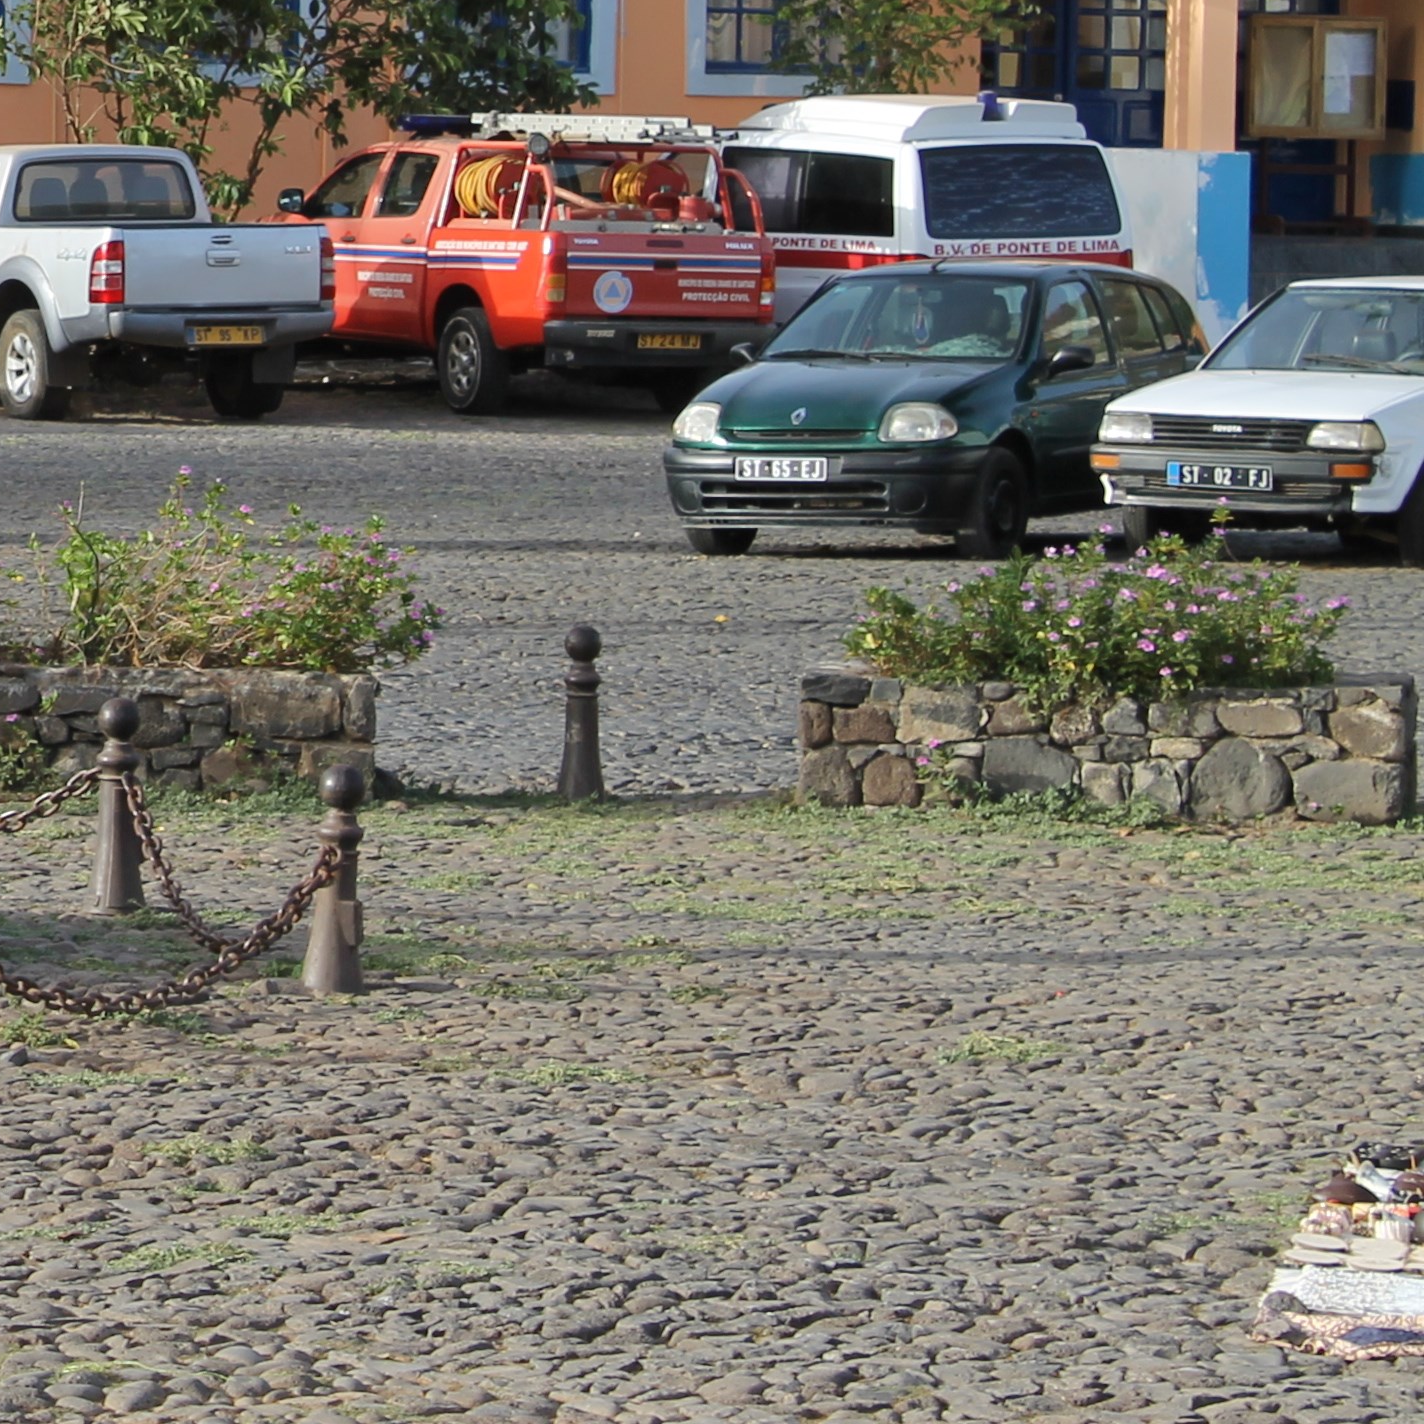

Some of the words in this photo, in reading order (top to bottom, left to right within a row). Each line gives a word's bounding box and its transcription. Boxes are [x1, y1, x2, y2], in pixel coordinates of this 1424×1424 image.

[772, 237, 816, 248] PONTE
[820, 239, 837, 249] DE
[842, 240, 877, 251] LIMA
[970, 243, 992, 255] DE
[997, 242, 1051, 254] PONTE
[1057, 240, 1078, 253] DE
[1082, 240, 1120, 252] LIMA
